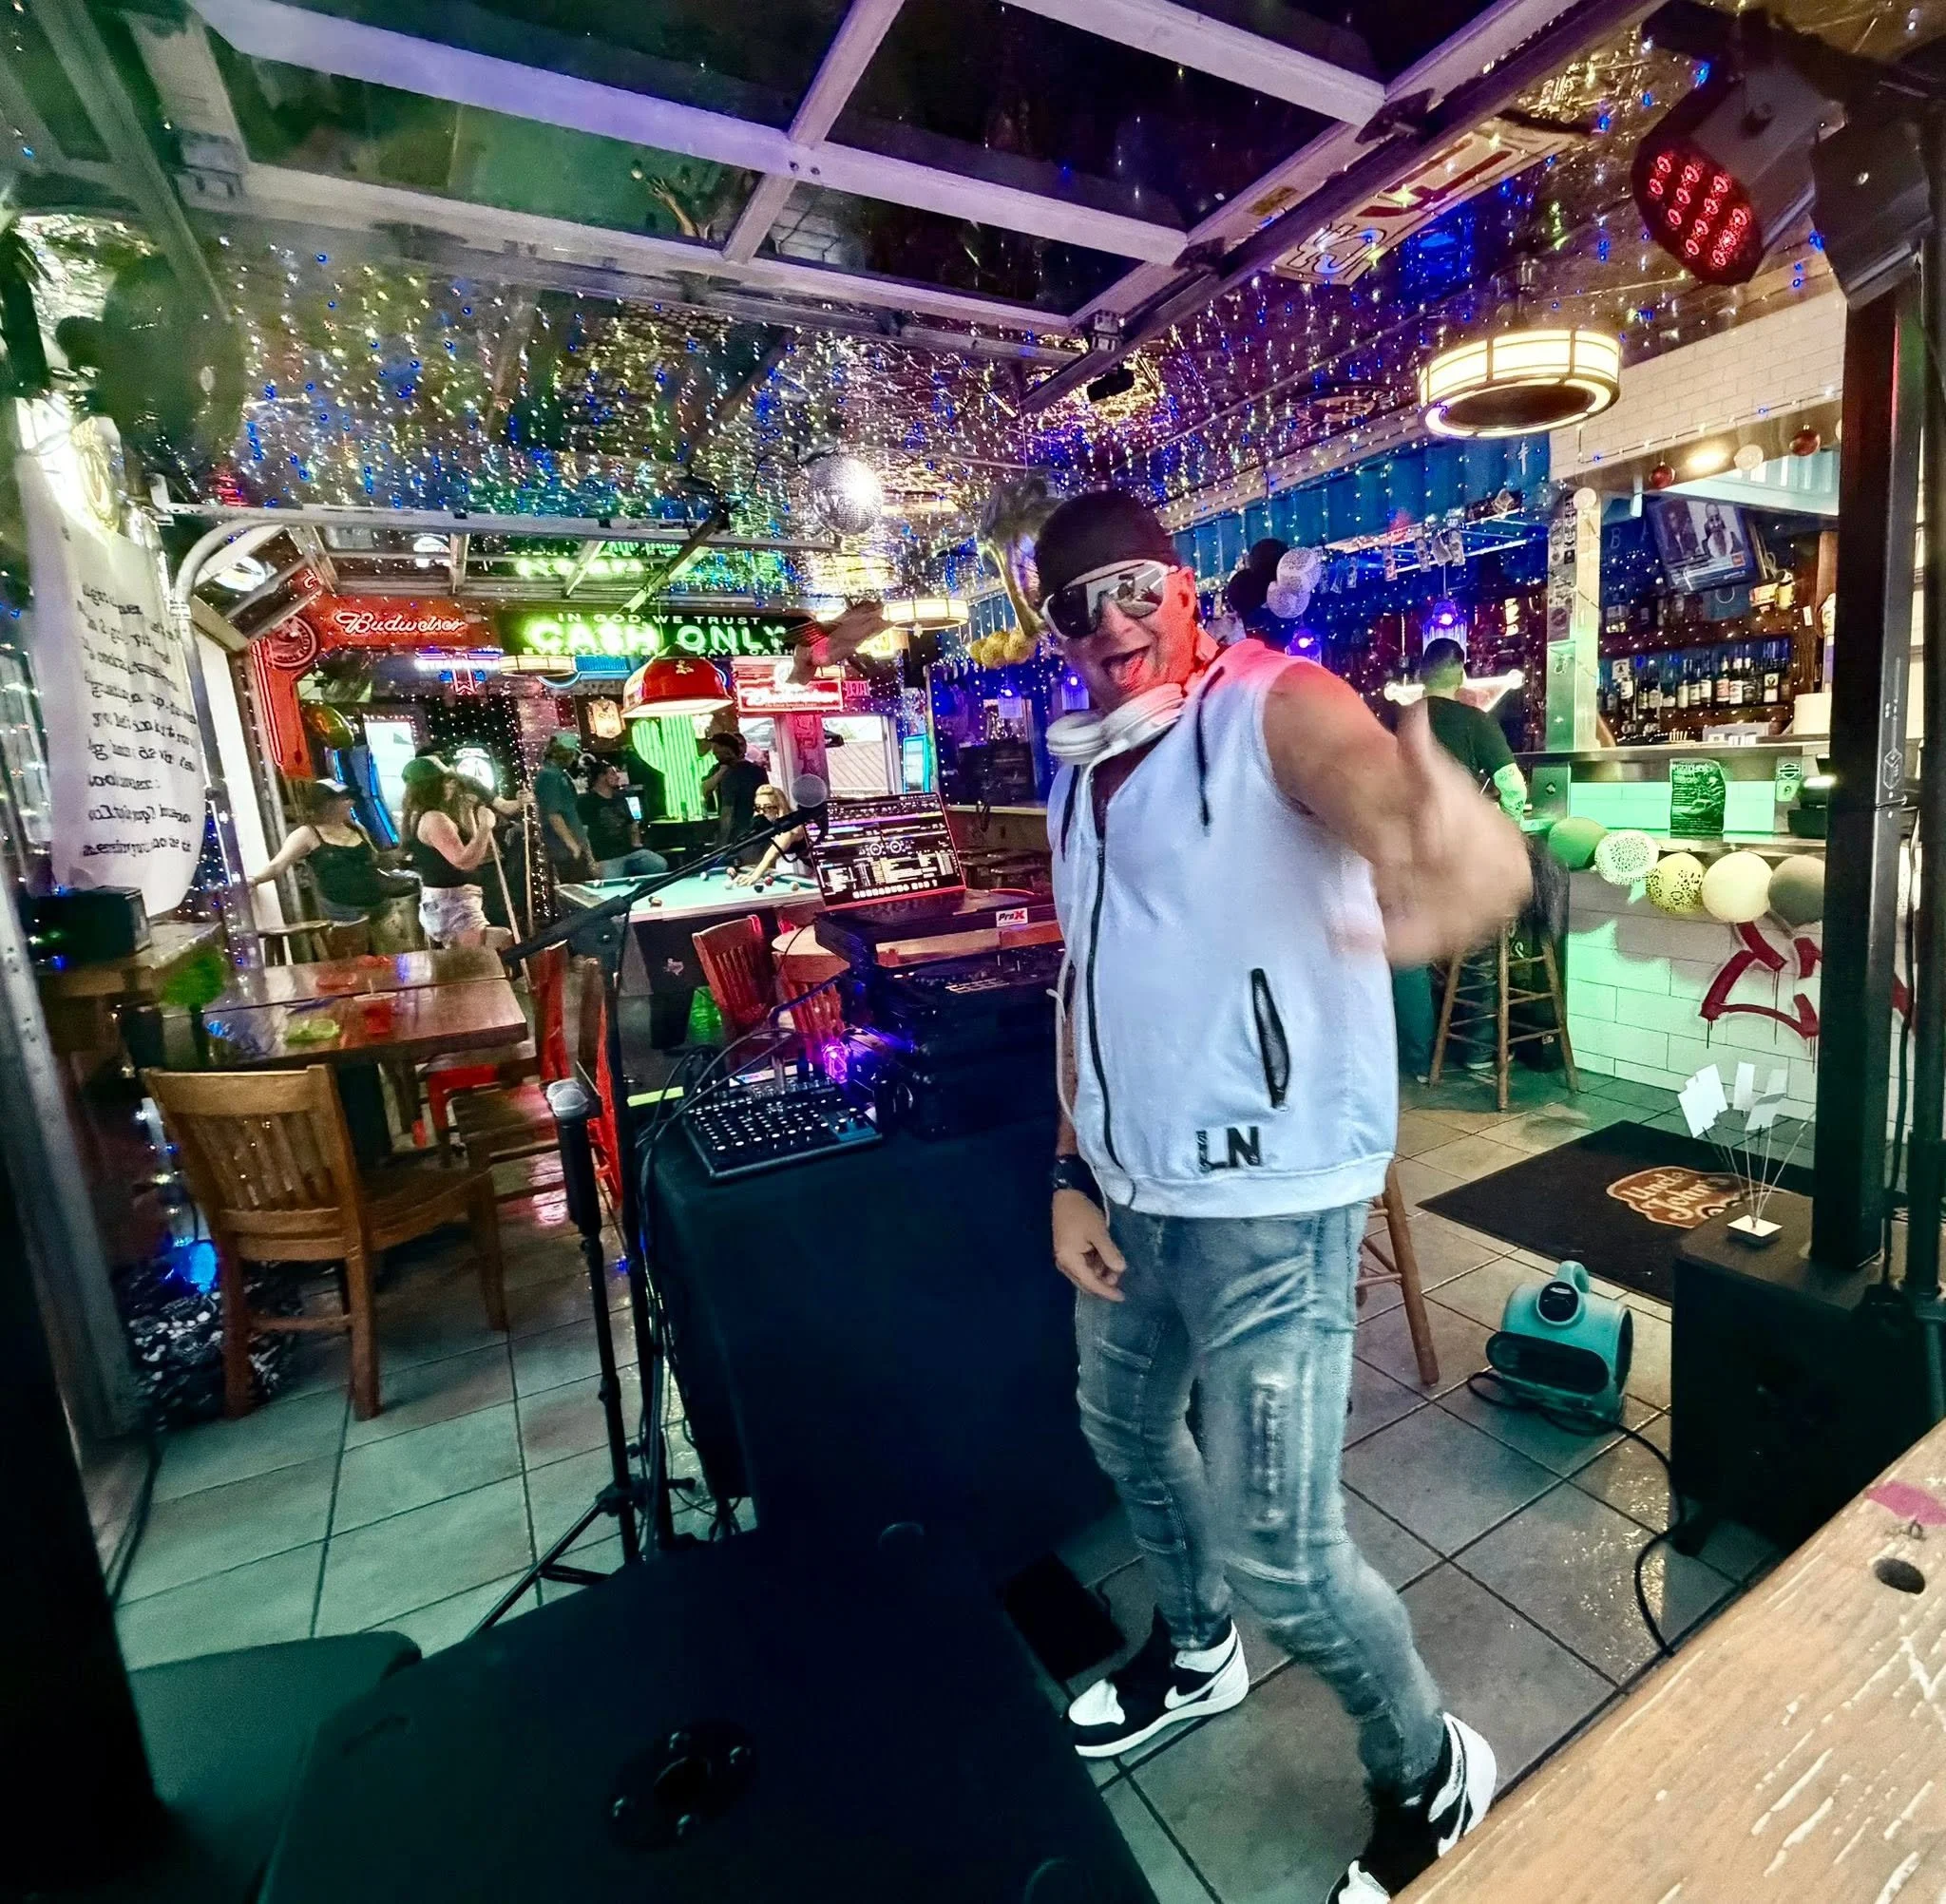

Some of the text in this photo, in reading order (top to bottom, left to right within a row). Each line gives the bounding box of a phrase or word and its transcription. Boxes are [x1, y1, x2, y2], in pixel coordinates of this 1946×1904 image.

[334, 611, 466, 634] Budweiser
[558, 613, 761, 625] IN GOD WE TRUST
[525, 619, 787, 654] CASH ONLY
[749, 648, 794, 657] CASH
[1196, 1126, 1262, 1173] LN
[1621, 1171, 1688, 1200] Uncle
